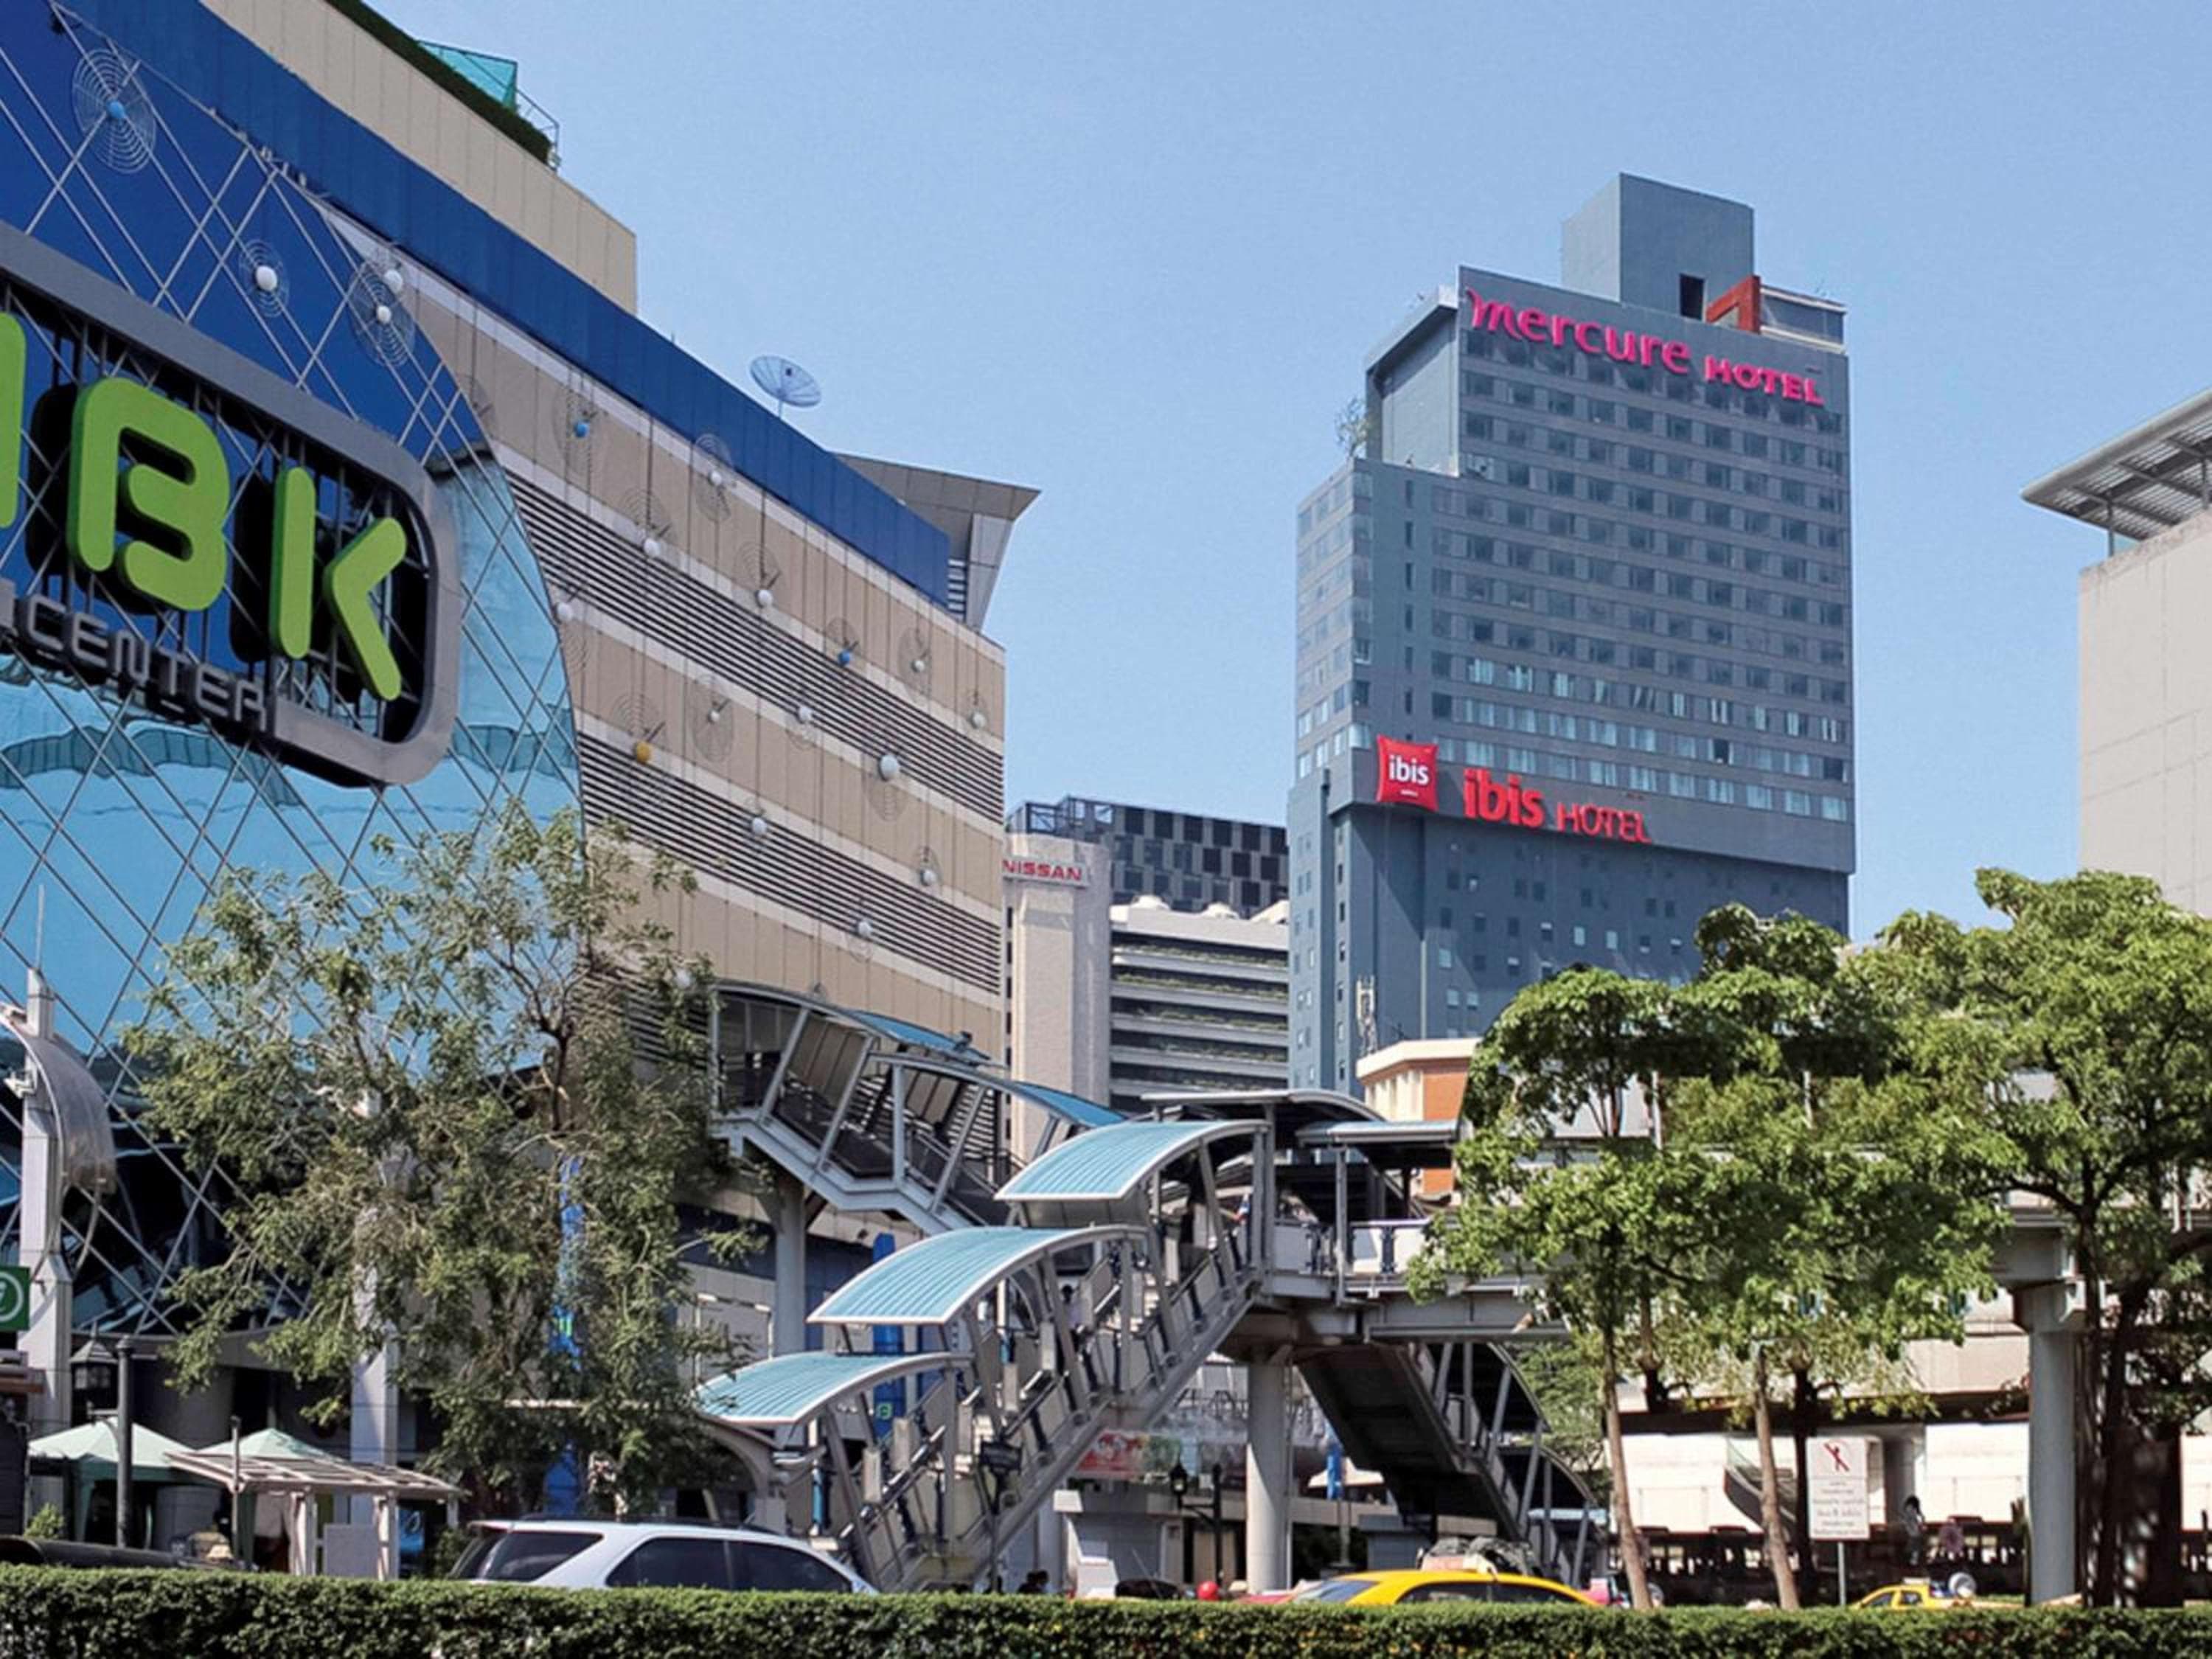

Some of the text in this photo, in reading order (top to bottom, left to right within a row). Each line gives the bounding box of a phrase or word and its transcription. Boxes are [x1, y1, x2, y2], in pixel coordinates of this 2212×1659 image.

[1704, 355, 1824, 406] HOTEL
[0, 311, 407, 701] BK
[27, 593, 268, 732] CENTER
[1389, 754, 1430, 786] ibis
[1462, 767, 1652, 844] ibis HOTEL
[1002, 860, 1082, 882] NISSAN
